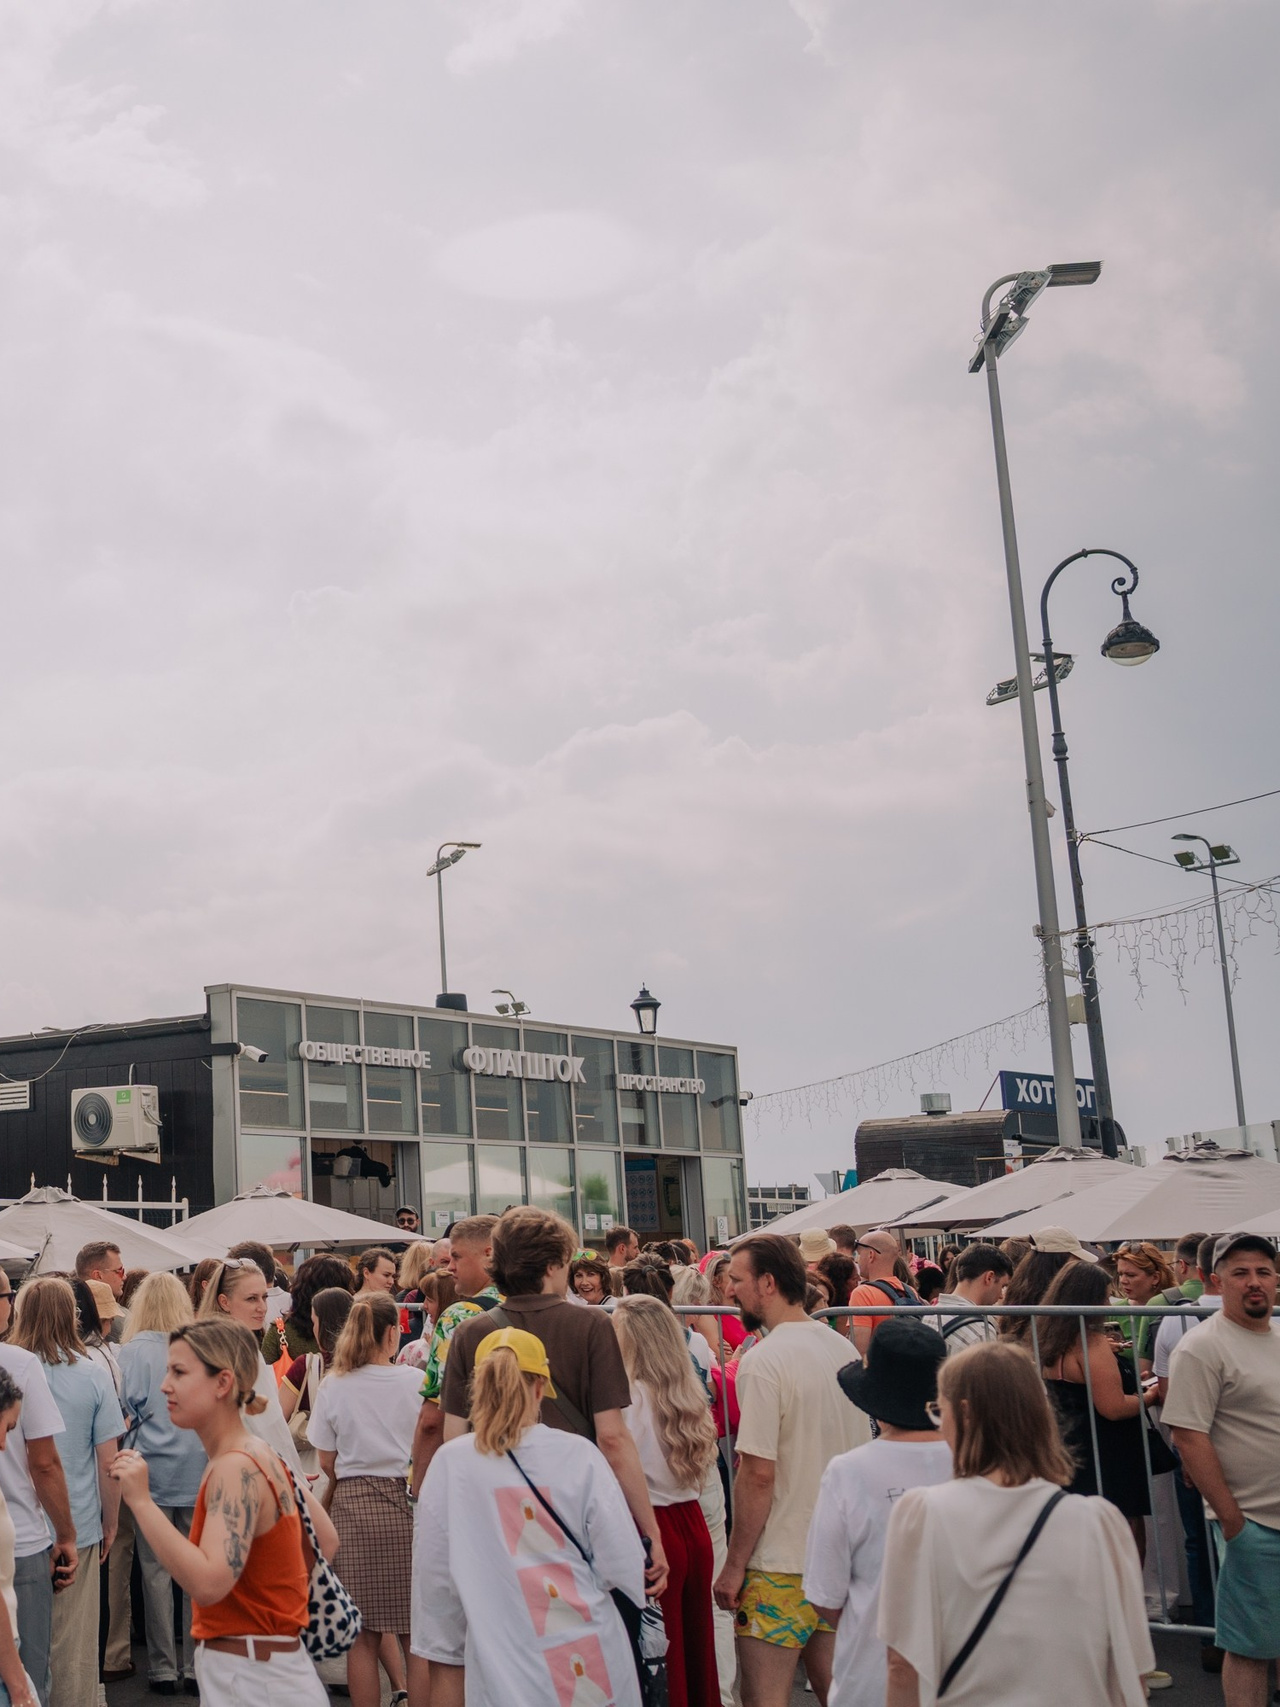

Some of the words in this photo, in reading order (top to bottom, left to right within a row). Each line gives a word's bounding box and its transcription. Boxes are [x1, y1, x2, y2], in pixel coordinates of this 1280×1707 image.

[300, 1041, 431, 1069] ОБЩЕСТВЕННОЕ
[464, 1045, 587, 1083] ФЛАГШТОК
[617, 1074, 706, 1094] ПРОСТРАНСТВО
[1015, 1078, 1095, 1109] ХОТОГ
